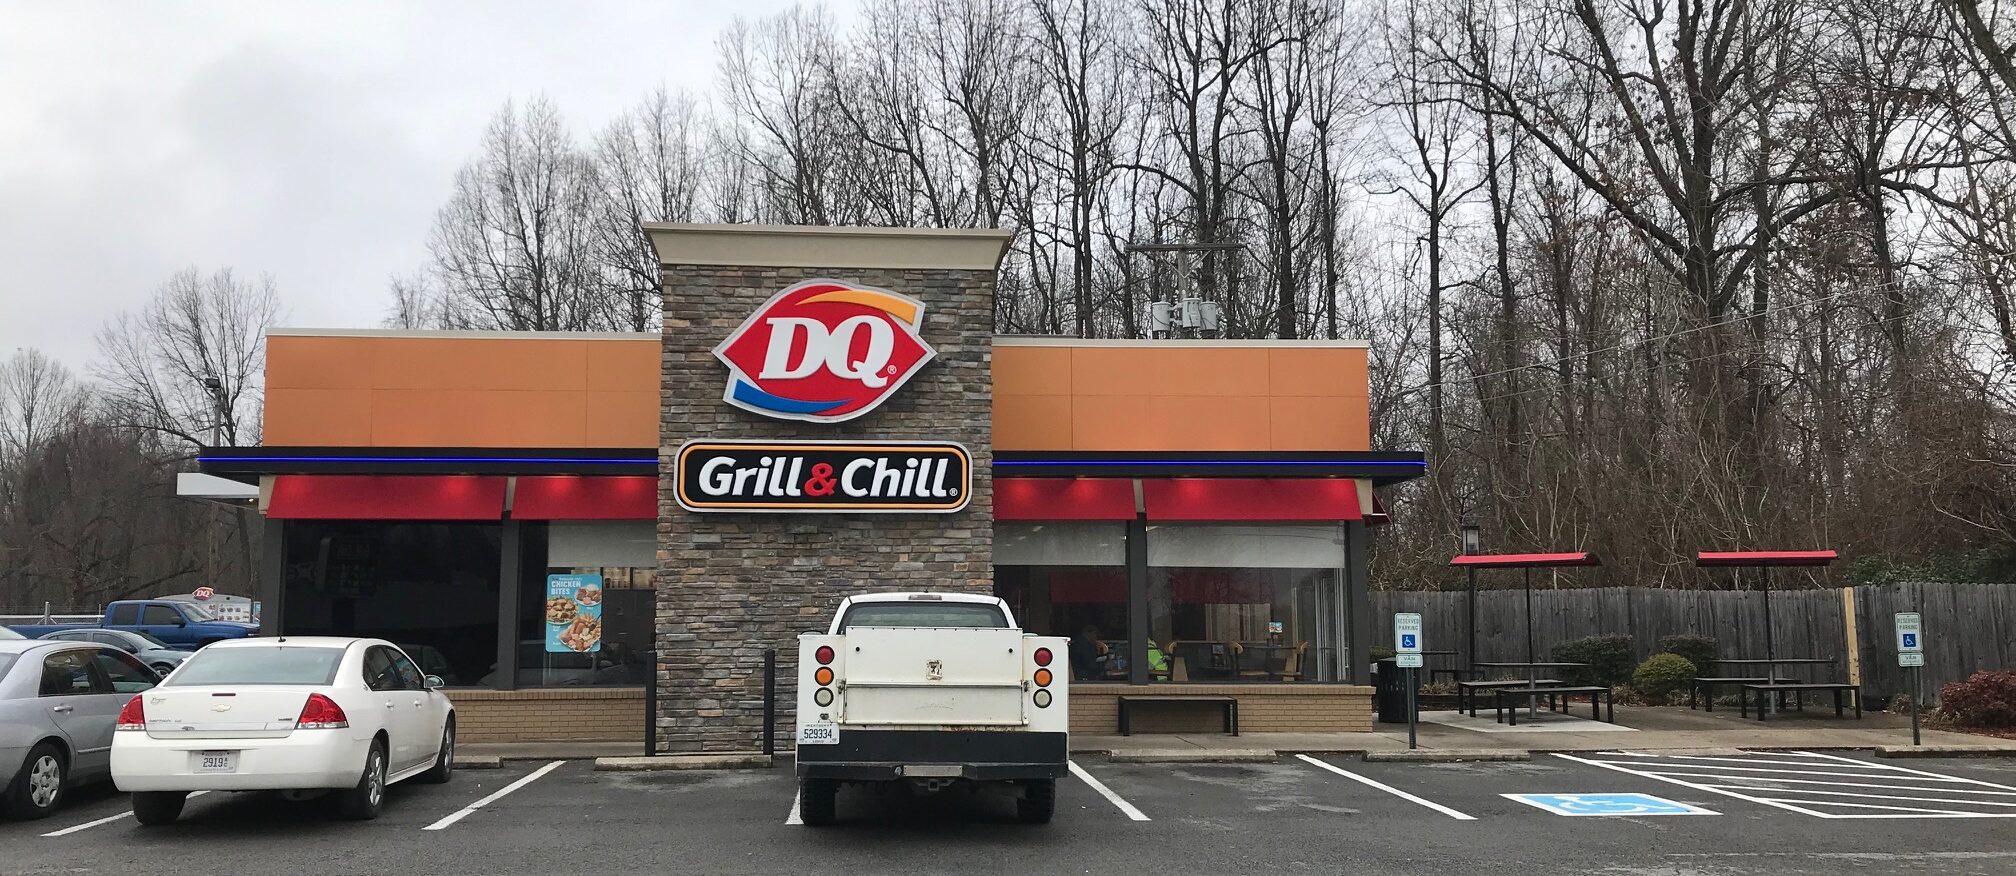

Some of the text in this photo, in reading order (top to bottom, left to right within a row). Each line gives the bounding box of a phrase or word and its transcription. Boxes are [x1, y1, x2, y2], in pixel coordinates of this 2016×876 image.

[698, 456, 804, 497] Grill
[841, 457, 949, 498] Chill
[551, 580, 581, 588] CHICKEN
[196, 590, 210, 598] DQ
[804, 729, 832, 739] 529334
[203, 757, 223, 767] 2919
